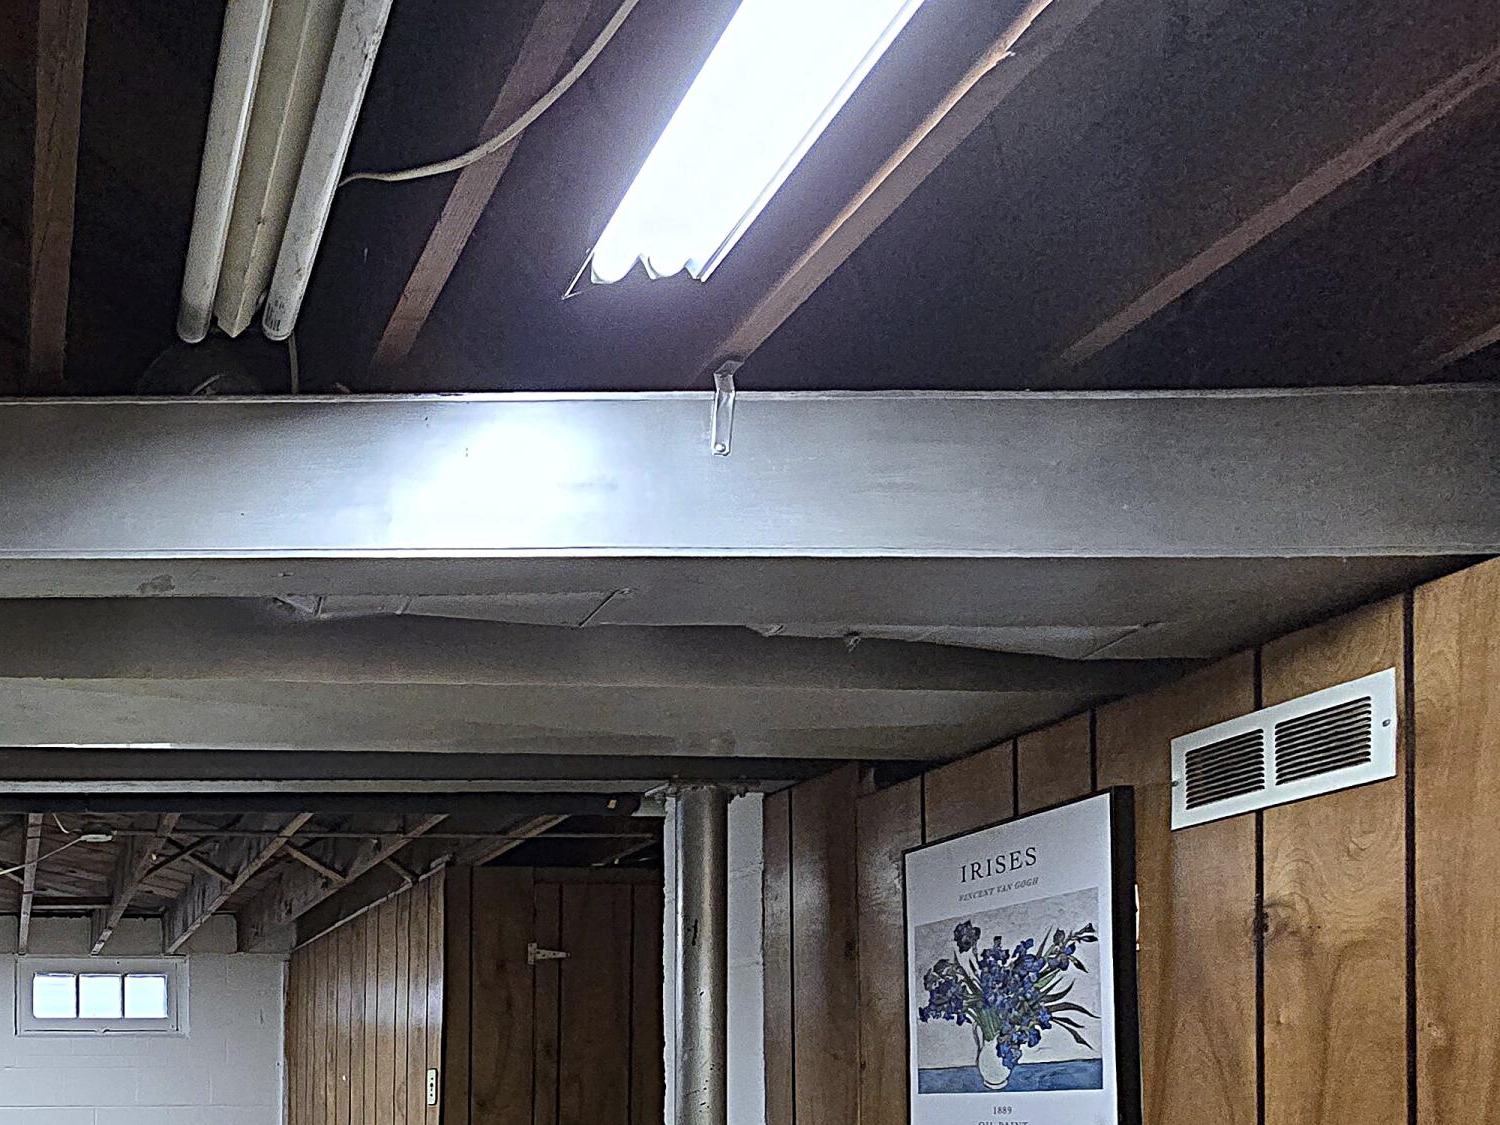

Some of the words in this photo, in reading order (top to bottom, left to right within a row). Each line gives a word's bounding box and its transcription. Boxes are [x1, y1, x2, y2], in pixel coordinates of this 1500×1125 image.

[960, 846, 1037, 883] IRISES
[958, 887, 995, 901] VINCENT
[996, 883, 1014, 893] VAN
[1014, 877, 1039, 890] GOGH
[993, 1106, 1012, 1115] 1889
